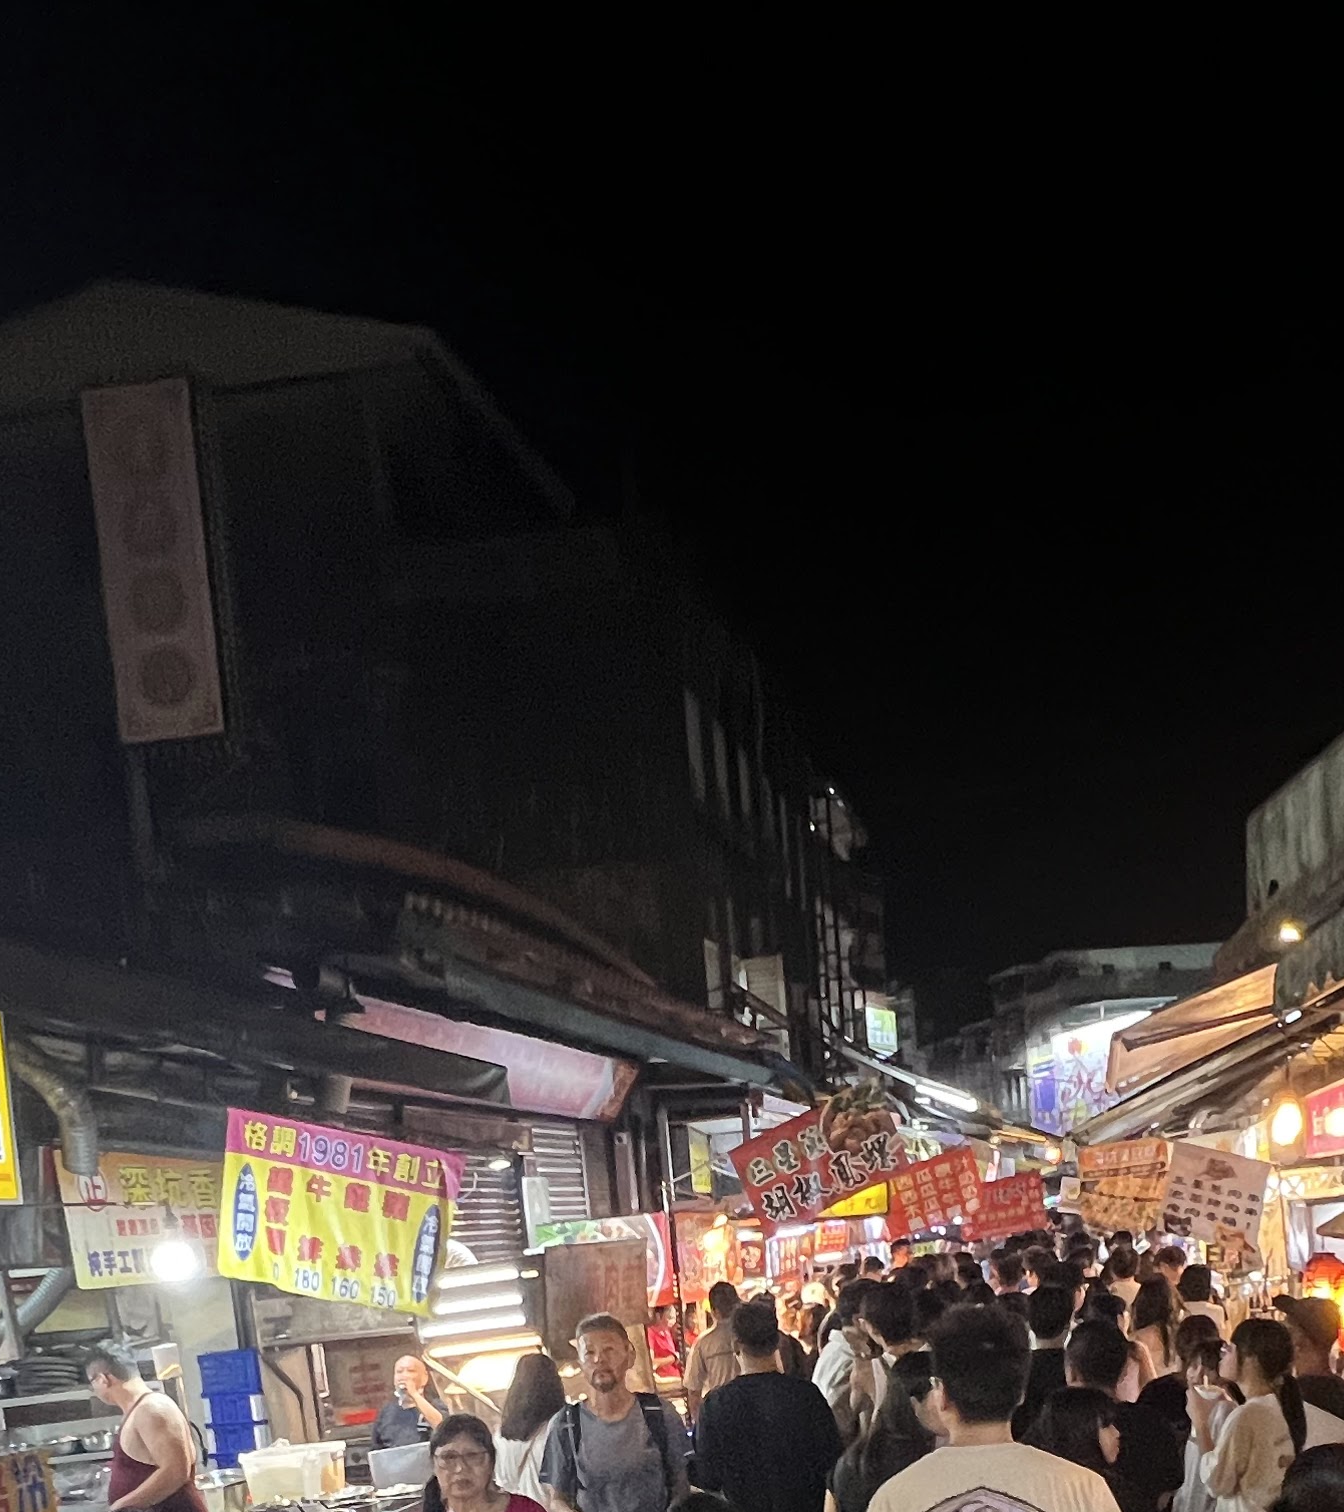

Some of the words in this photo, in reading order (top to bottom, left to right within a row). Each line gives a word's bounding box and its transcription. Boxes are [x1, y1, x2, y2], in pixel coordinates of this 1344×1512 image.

[293, 1266, 320, 1292] 180
[331, 1275, 361, 1300] 160
[370, 1283, 397, 1309] 150
